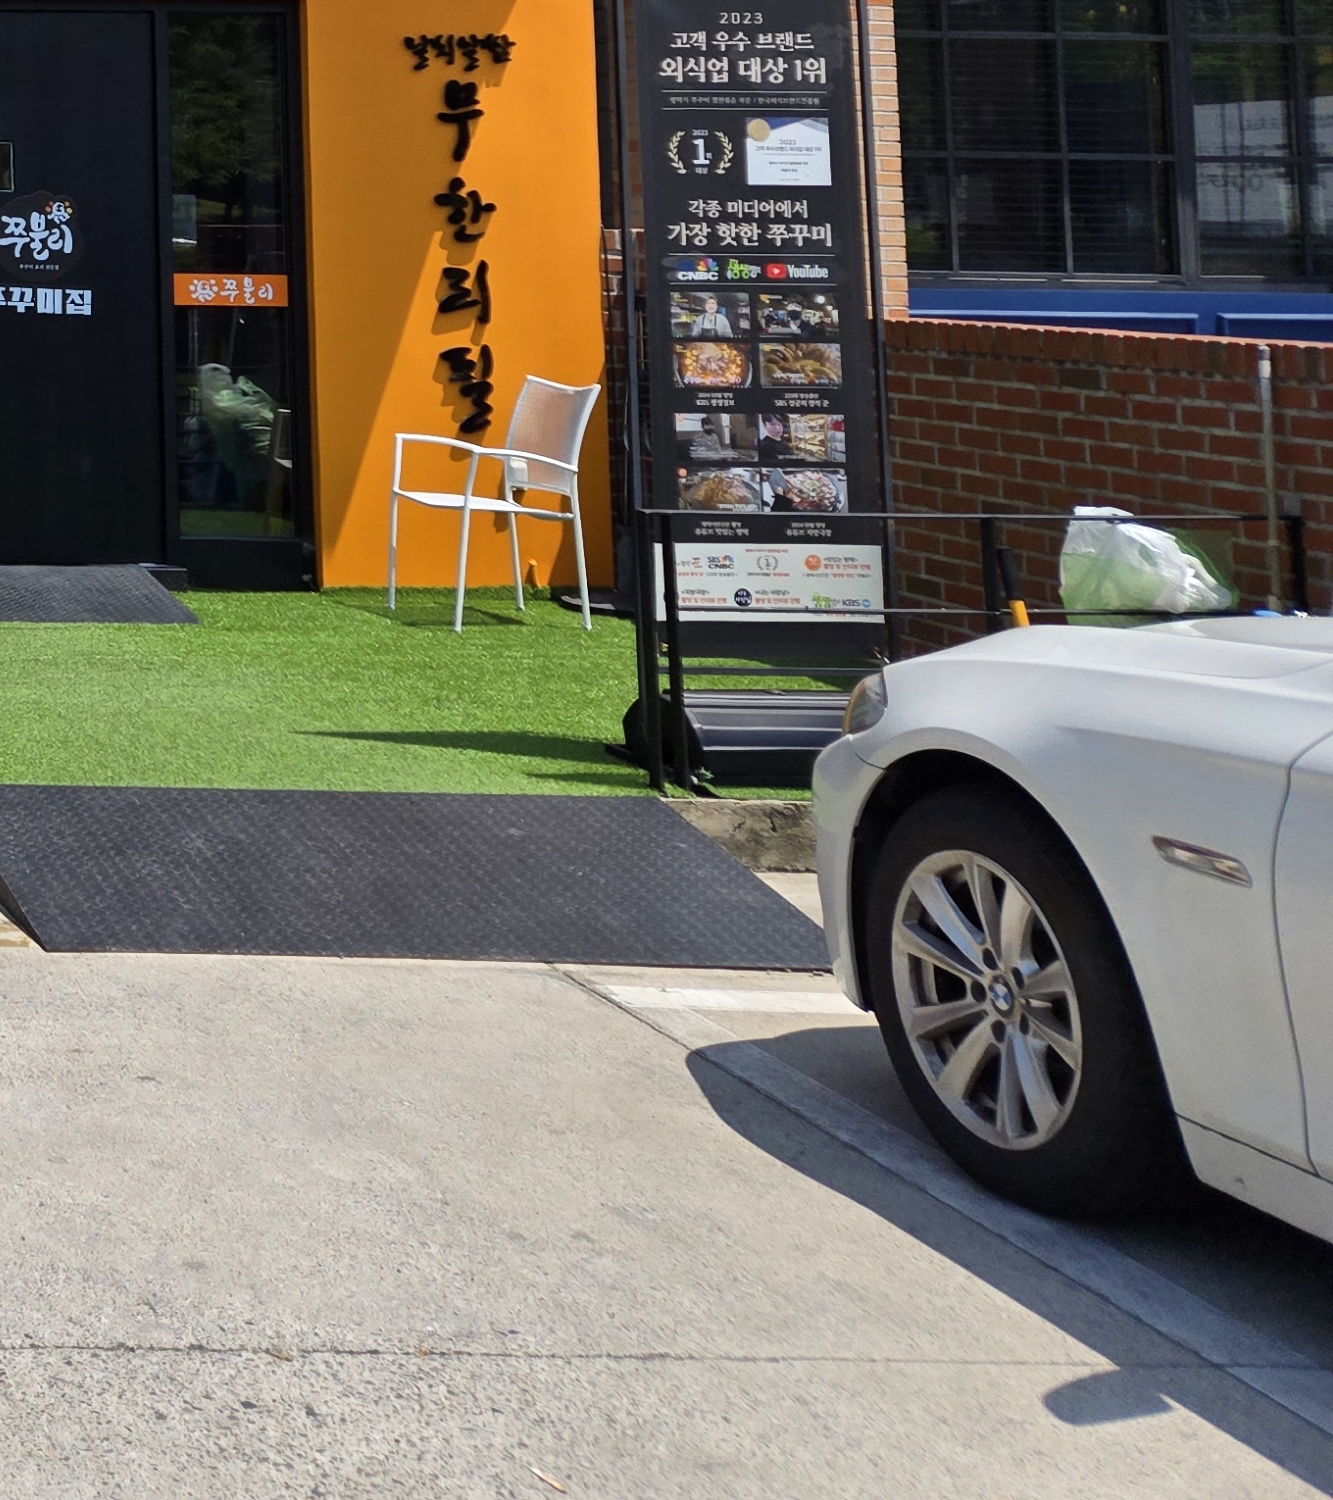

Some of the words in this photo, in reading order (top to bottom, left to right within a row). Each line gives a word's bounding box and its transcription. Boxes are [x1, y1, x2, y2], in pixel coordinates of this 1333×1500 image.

[719, 12, 764, 25] 2023
[669, 30, 707, 51] 고객
[710, 31, 752, 52] 우수
[755, 31, 815, 52] 브랜드
[658, 56, 729, 83] 외식업
[737, 57, 789, 84] 대상
[793, 58, 827, 84] 1위
[688, 200, 723, 219] 각종
[727, 200, 809, 220] 미디어에서
[668, 222, 711, 246] 가장
[717, 222, 762, 247] 핫한
[766, 223, 833, 247] 쭈꾸미
[677, 271, 719, 281] CNBC
[787, 263, 829, 279] YouTube
[219, 275, 274, 304] 쭈불리
